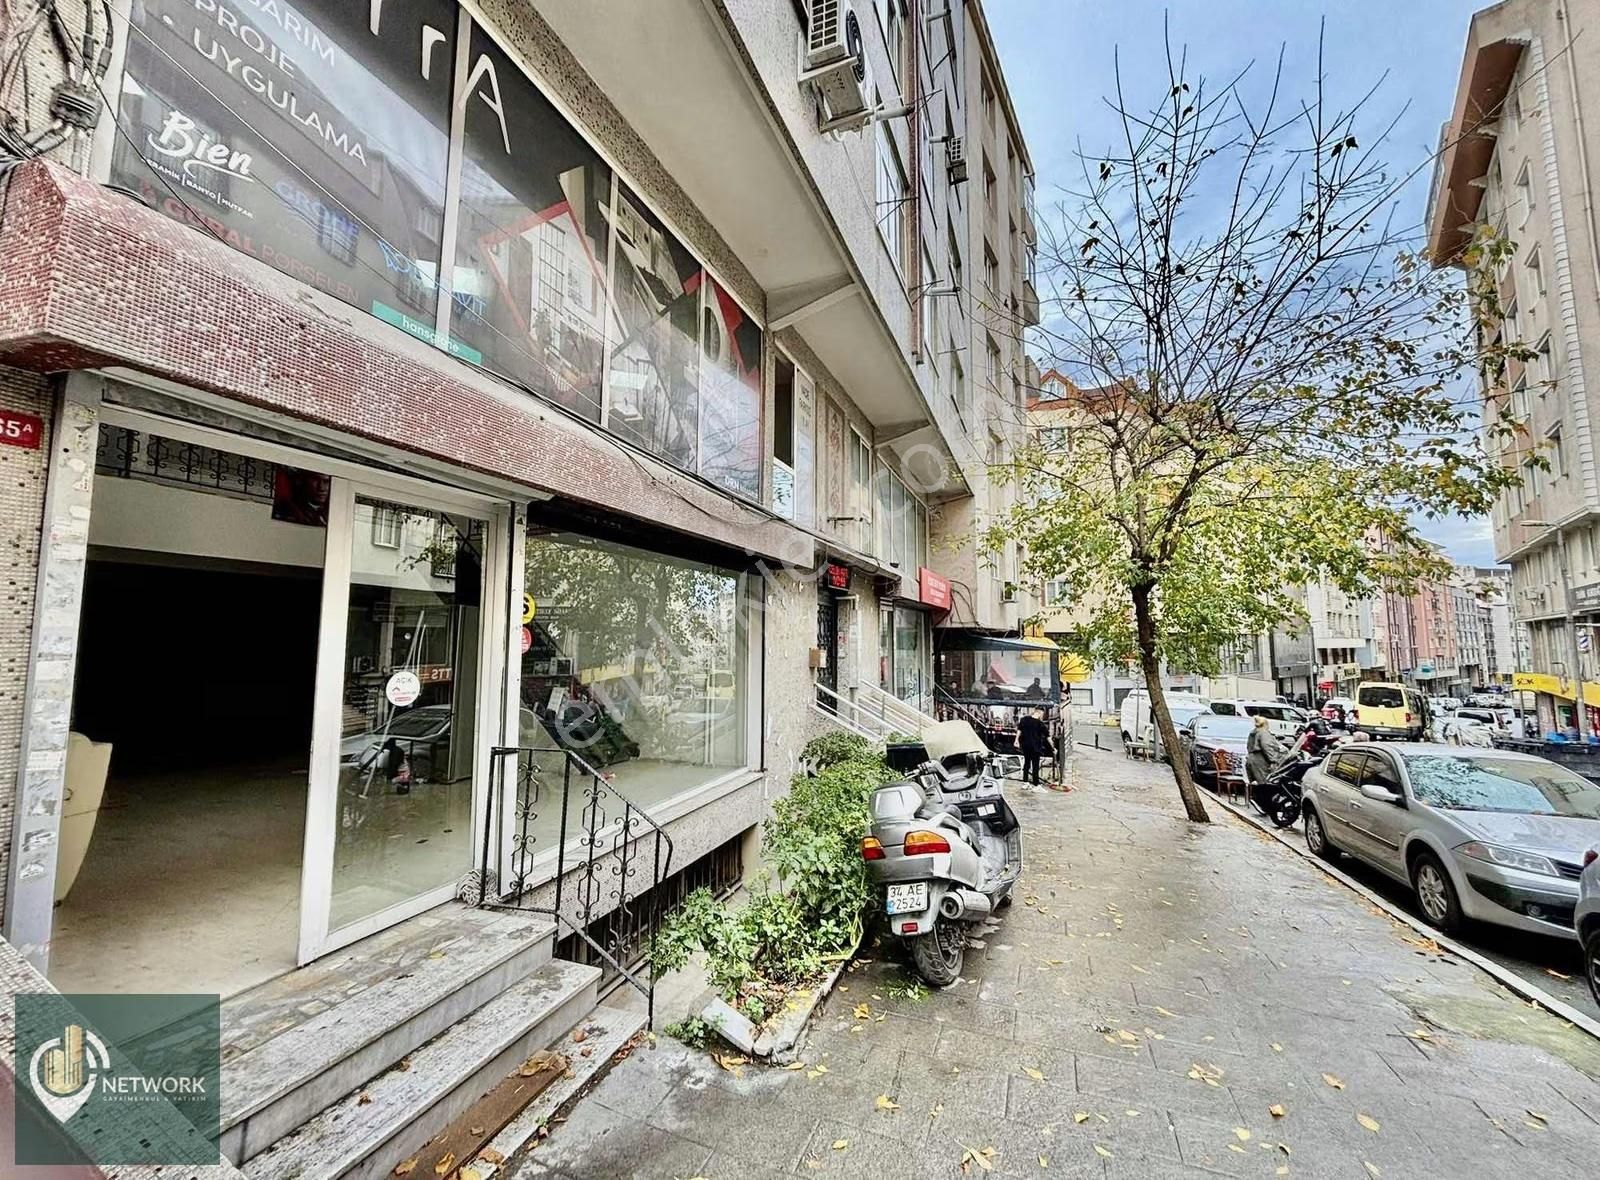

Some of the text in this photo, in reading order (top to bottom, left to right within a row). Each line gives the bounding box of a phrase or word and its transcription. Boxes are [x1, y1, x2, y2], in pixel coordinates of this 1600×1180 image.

[247, 0, 335, 68] ARIM
[193, 27, 368, 167] UYGULAMA
[147, 109, 255, 183] Bien
[896, 897, 921, 910] 2524
